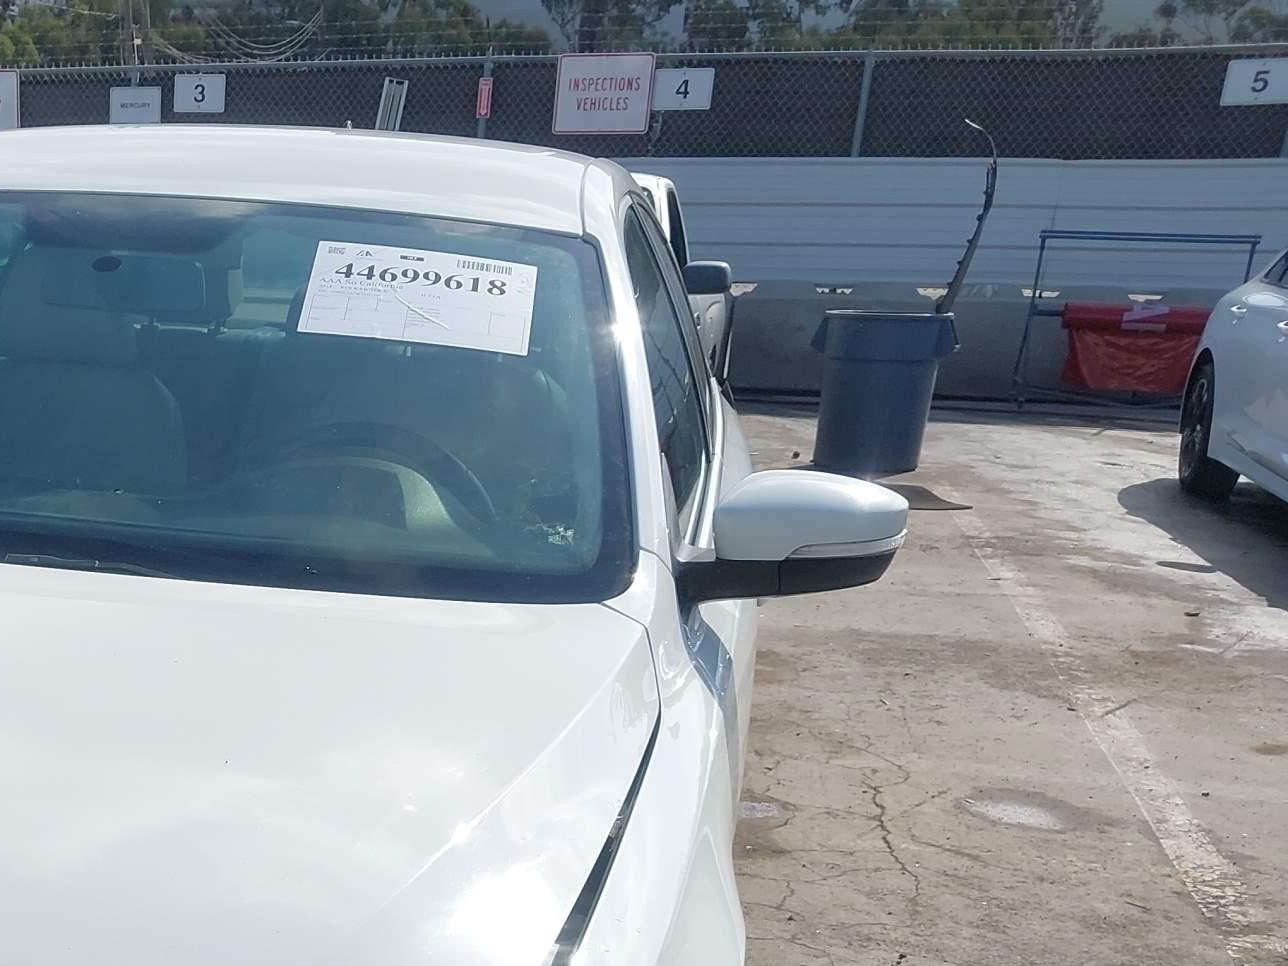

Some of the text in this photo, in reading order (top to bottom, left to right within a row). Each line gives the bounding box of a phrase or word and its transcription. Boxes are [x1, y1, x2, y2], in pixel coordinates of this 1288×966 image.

[568, 77, 641, 92] INSPECTIONS
[675, 79, 690, 99] 4
[1251, 70, 1271, 92] 5
[193, 83, 206, 103] 3
[576, 97, 629, 111] VEHICLES
[334, 262, 507, 296] 44699618
